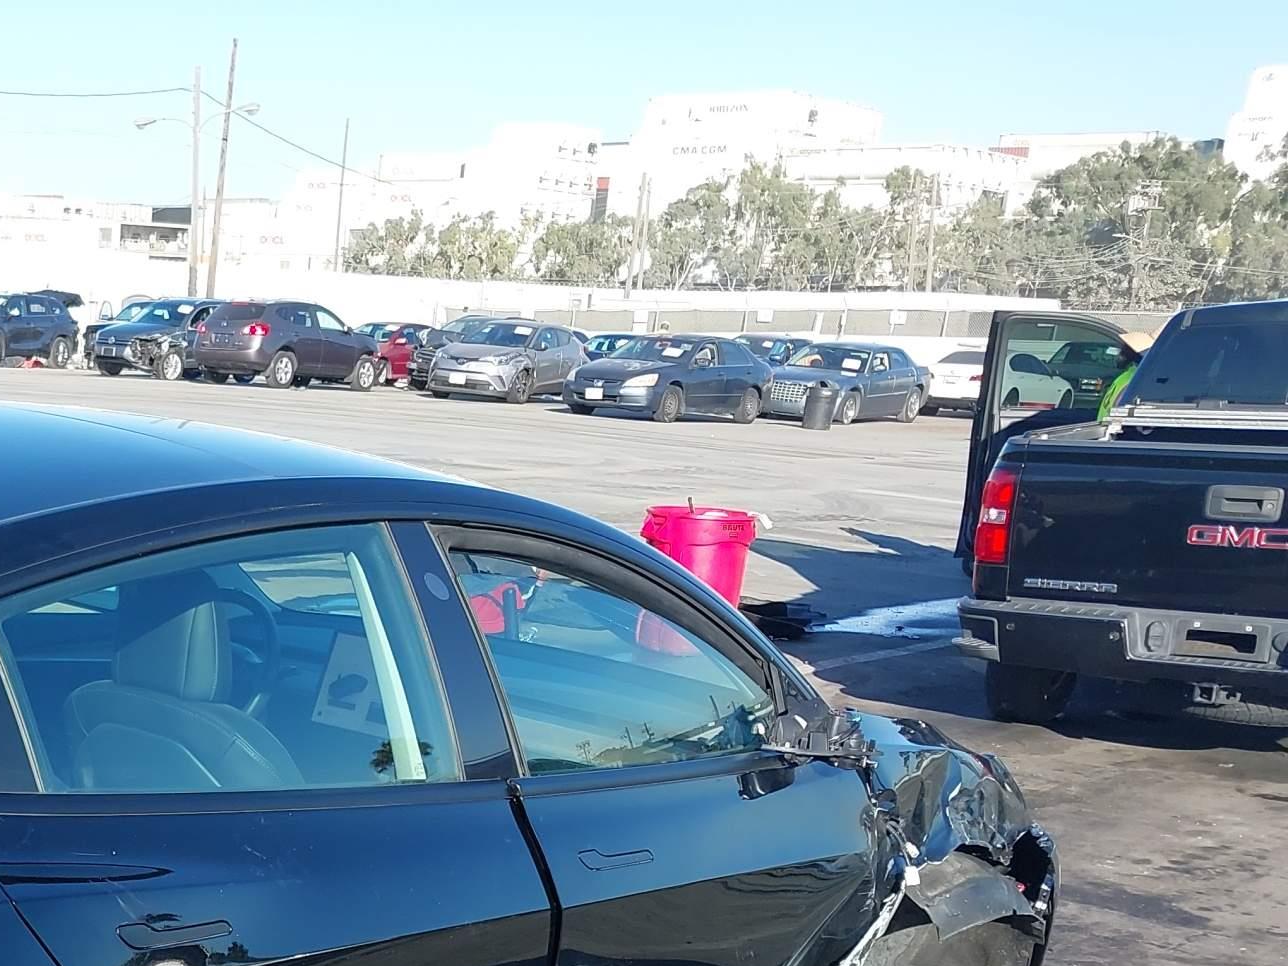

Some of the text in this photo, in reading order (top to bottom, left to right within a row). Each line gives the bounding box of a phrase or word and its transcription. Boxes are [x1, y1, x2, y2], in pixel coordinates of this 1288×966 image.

[672, 144, 727, 156] CMA CGM
[1186, 524, 1288, 550] GMC
[1023, 577, 1118, 594] SIERRA
